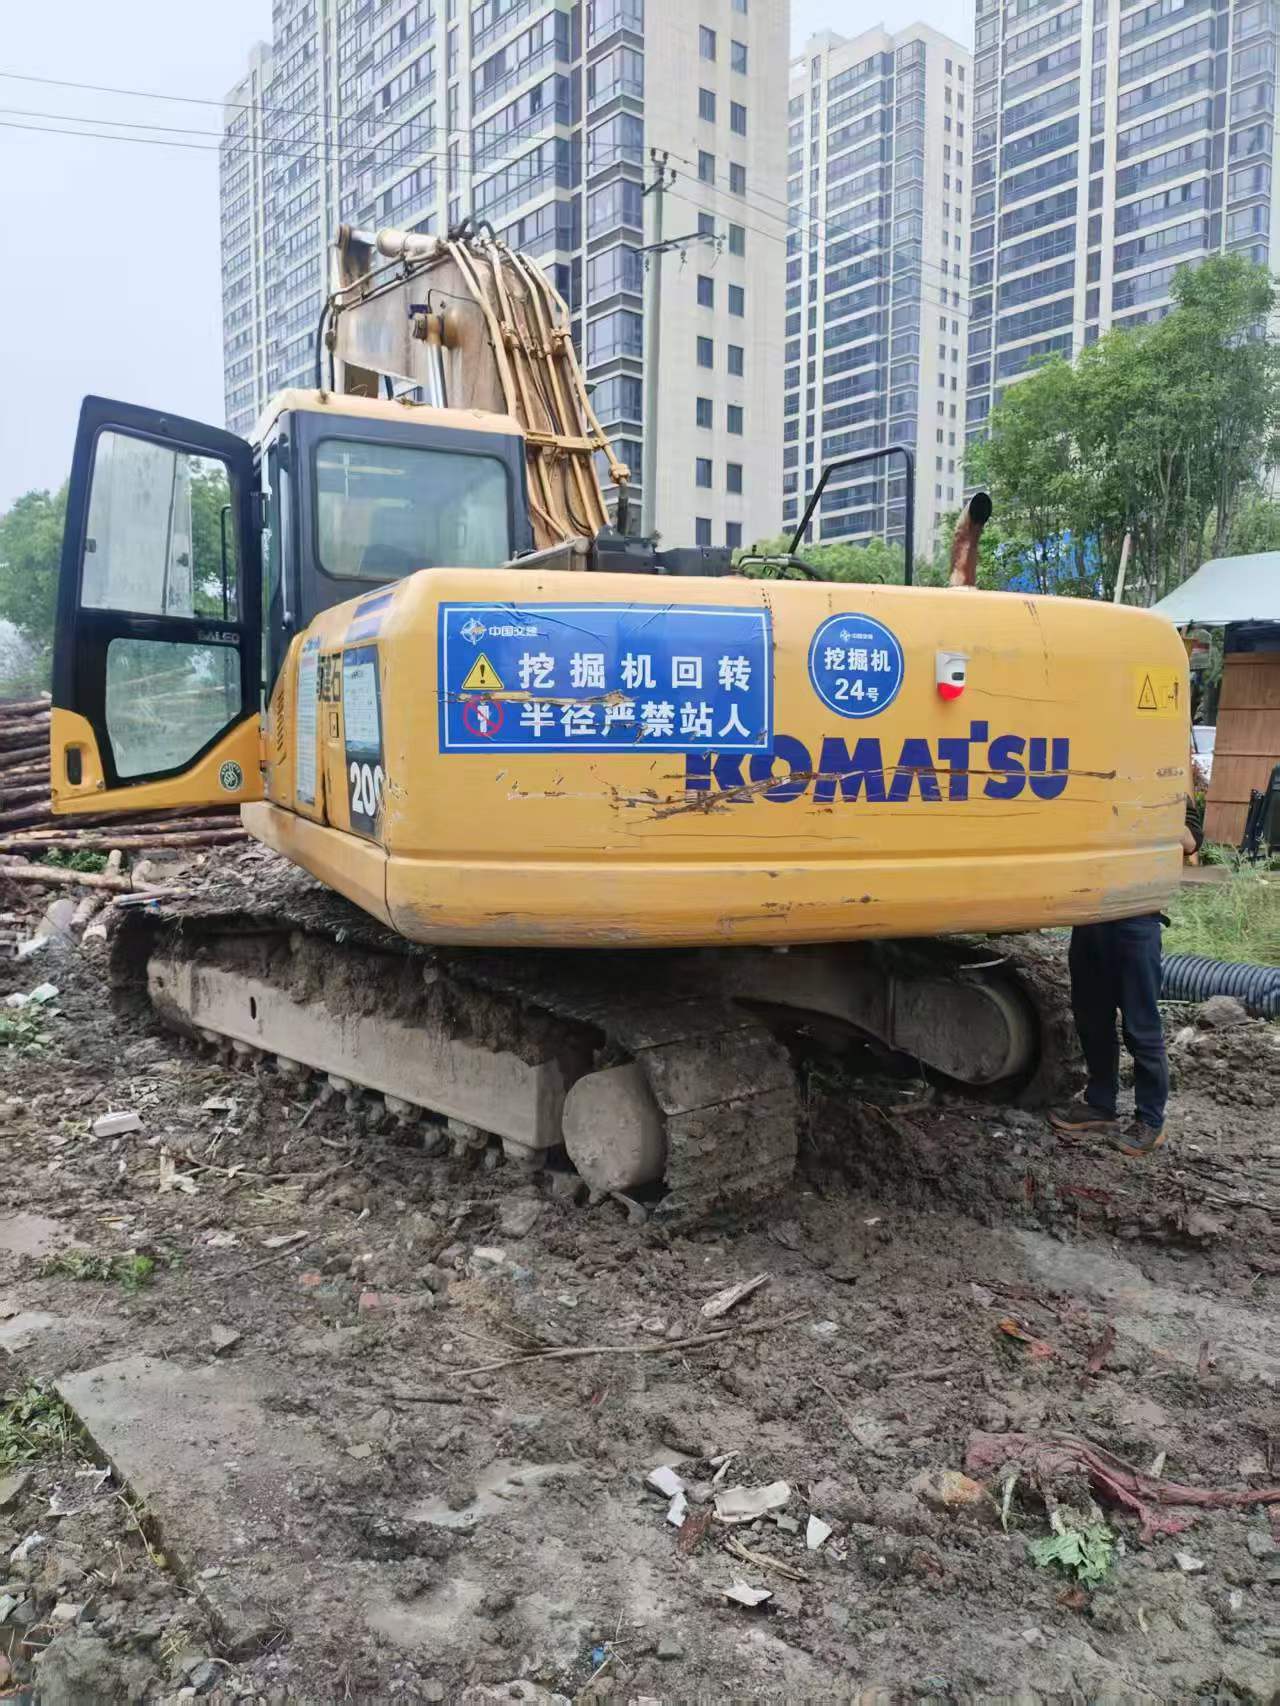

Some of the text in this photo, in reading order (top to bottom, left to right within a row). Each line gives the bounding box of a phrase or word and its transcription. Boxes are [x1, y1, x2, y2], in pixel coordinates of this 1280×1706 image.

[518, 652, 752, 691] 挖掘机回转
[824, 647, 891, 673] 挖掘机
[834, 678, 879, 702] 24号
[520, 701, 751, 738] 半径严禁站人
[686, 720, 1069, 803] KOMATSU
